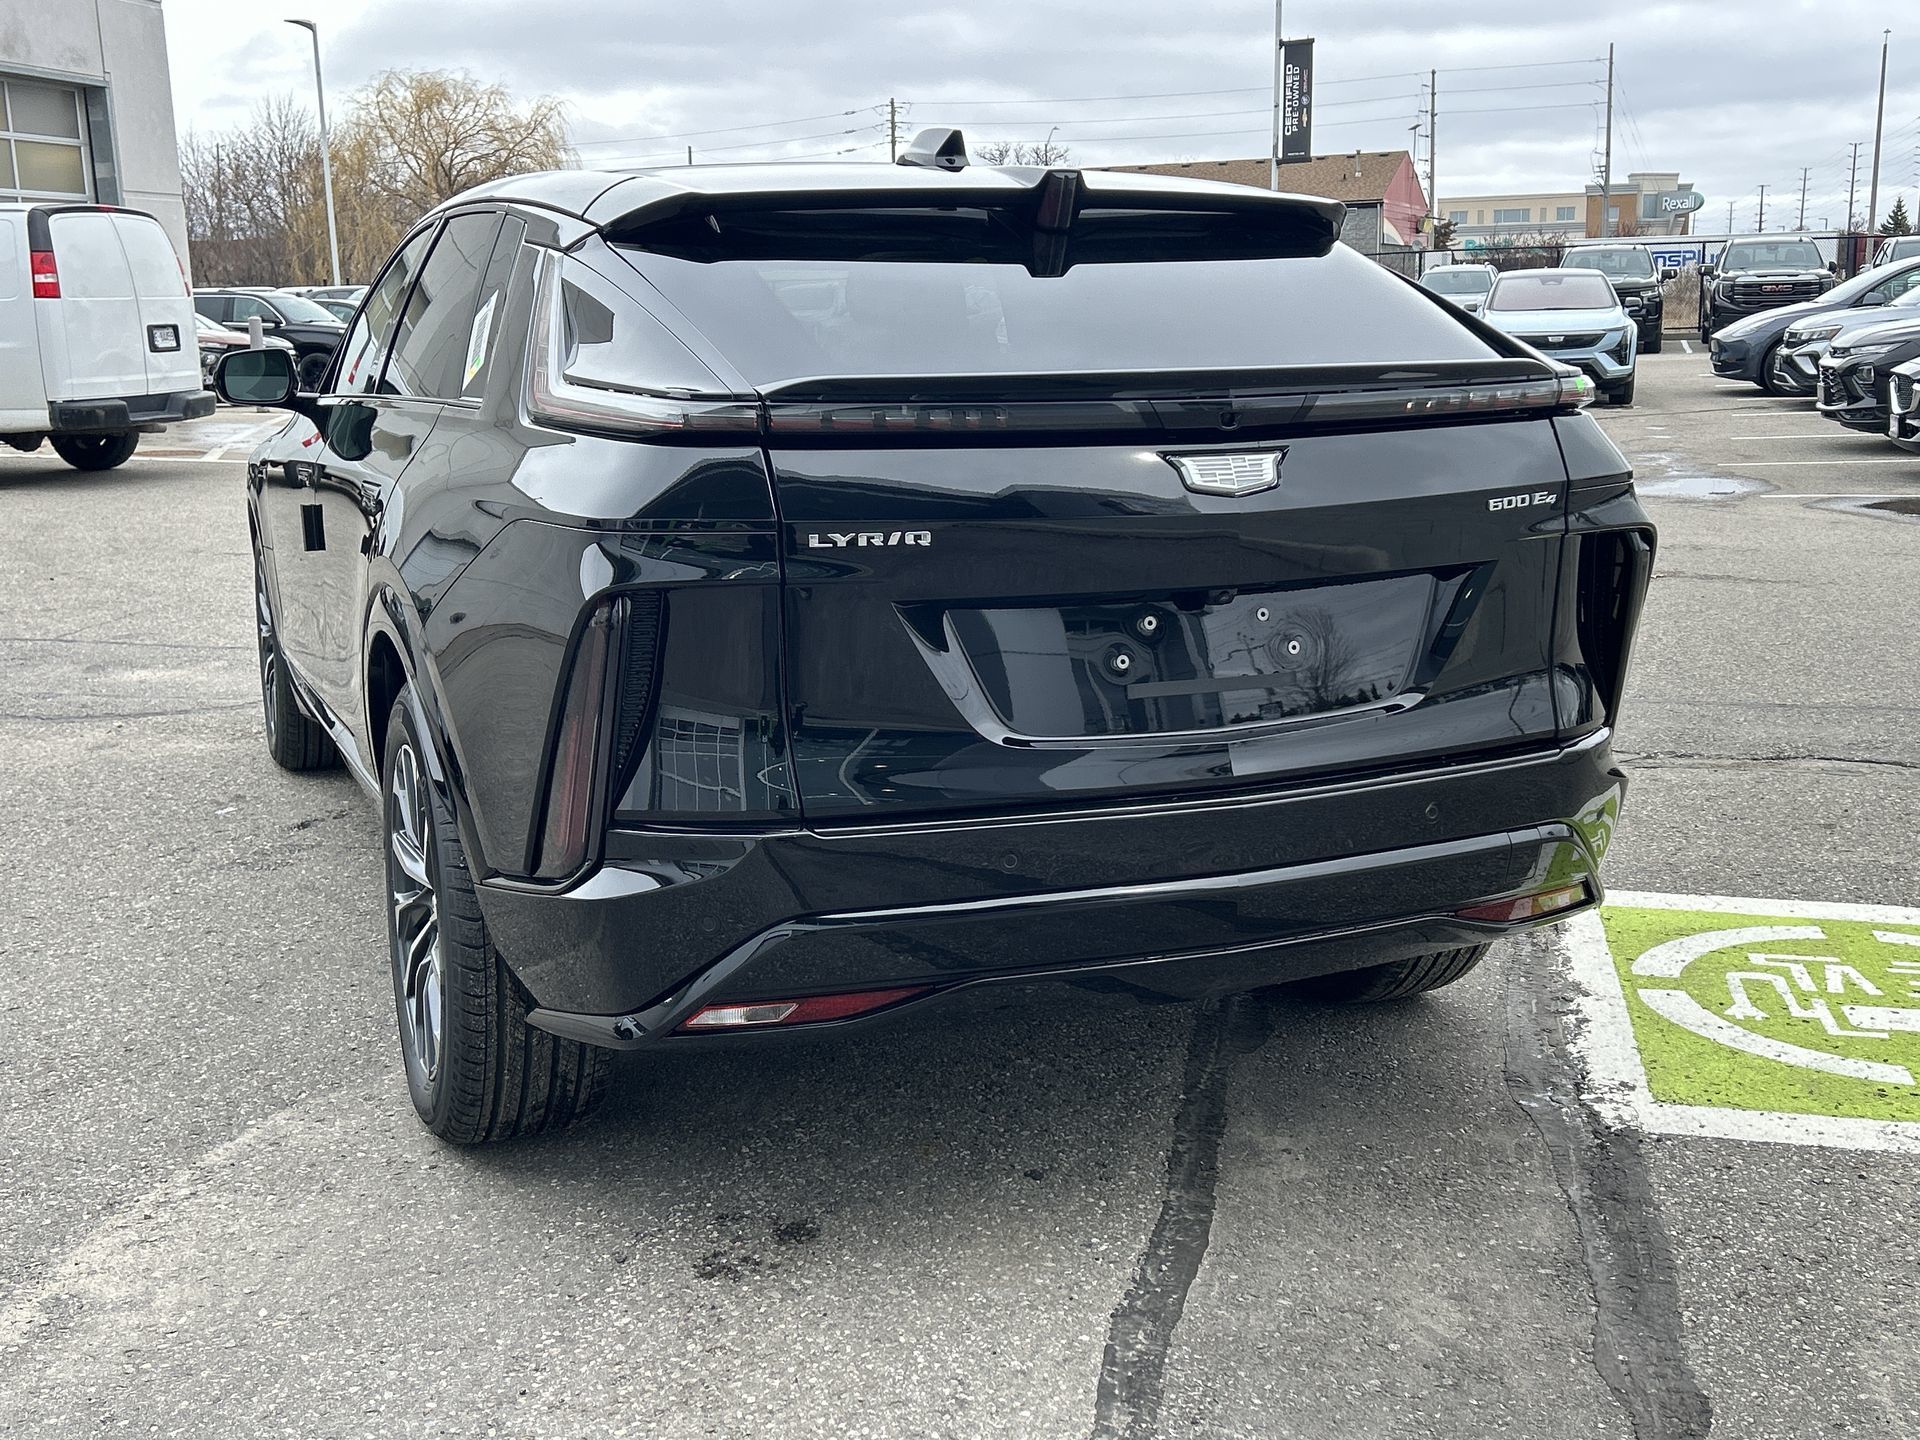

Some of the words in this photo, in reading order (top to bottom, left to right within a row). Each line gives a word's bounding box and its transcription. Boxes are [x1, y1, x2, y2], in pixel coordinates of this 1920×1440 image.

[1284, 63, 1293, 136] CERTIFIED
[1292, 66, 1300, 132] PRE-OWNED
[1662, 195, 1695, 212] Rexall
[1761, 284, 1793, 292] GMC
[1488, 494, 1530, 512] 600
